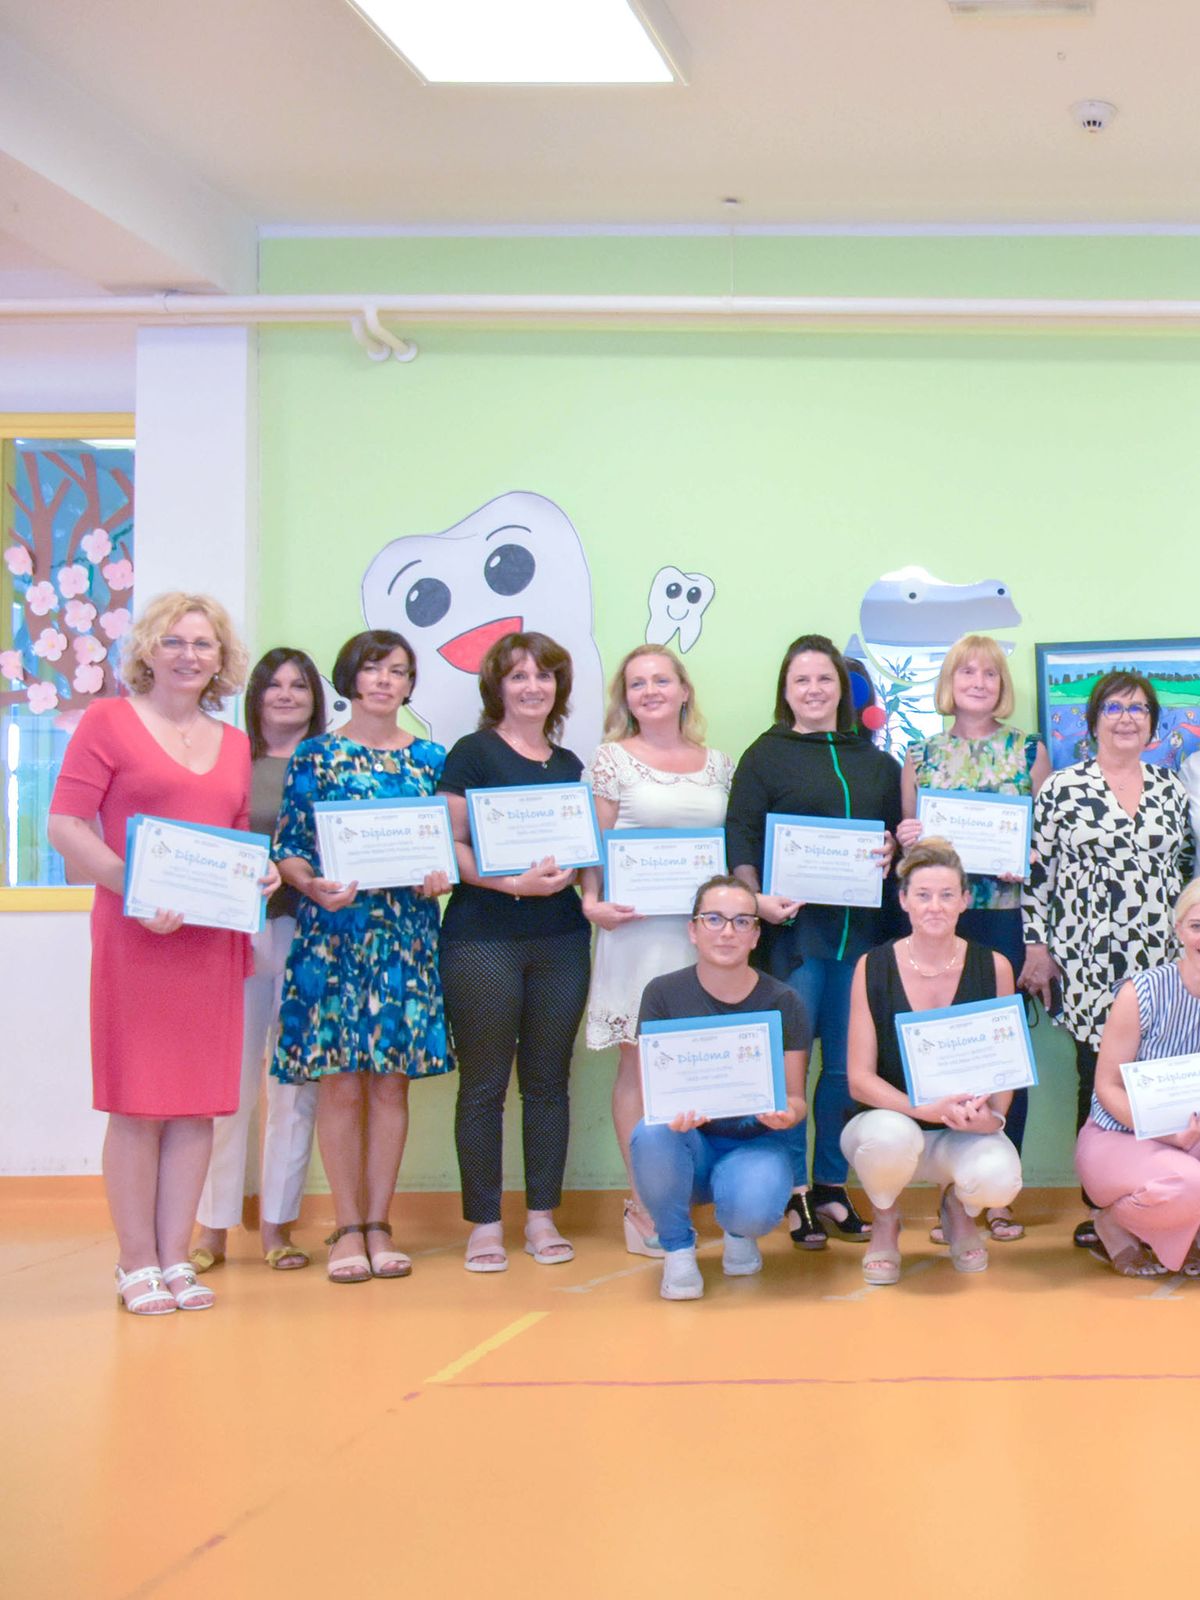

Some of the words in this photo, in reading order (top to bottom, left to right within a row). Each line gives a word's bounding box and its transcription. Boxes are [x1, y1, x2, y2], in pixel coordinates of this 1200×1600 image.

[507, 808, 555, 822] Diploma
[950, 816, 993, 828] Diploma
[361, 827, 412, 840] Diploma
[804, 844, 849, 857] Diploma
[174, 848, 228, 870] Diploma
[640, 856, 687, 868] Diploma
[937, 1033, 987, 1051] Diploma
[677, 1050, 731, 1066] Diploma
